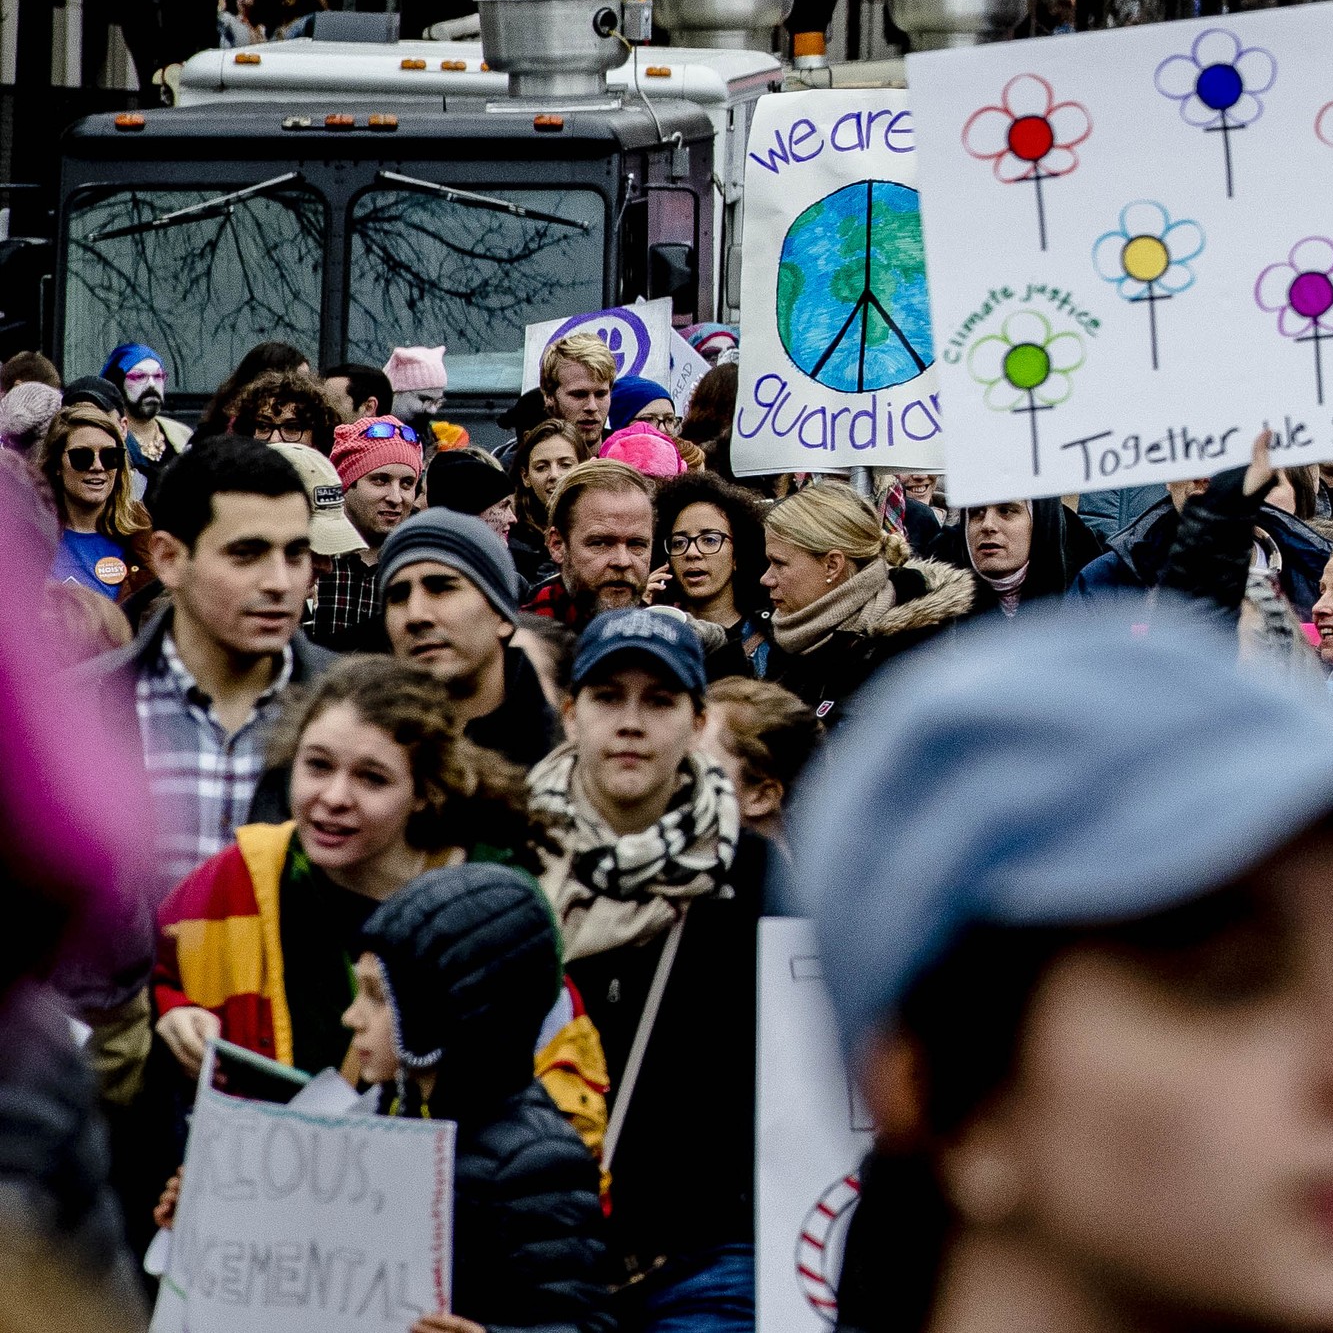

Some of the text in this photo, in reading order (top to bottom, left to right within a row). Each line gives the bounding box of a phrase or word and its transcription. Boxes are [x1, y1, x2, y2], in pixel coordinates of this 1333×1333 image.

[749, 118, 825, 174] we
[1019, 283, 1102, 338] justice
[672, 362, 693, 401] READ
[1061, 424, 1240, 482] Together
